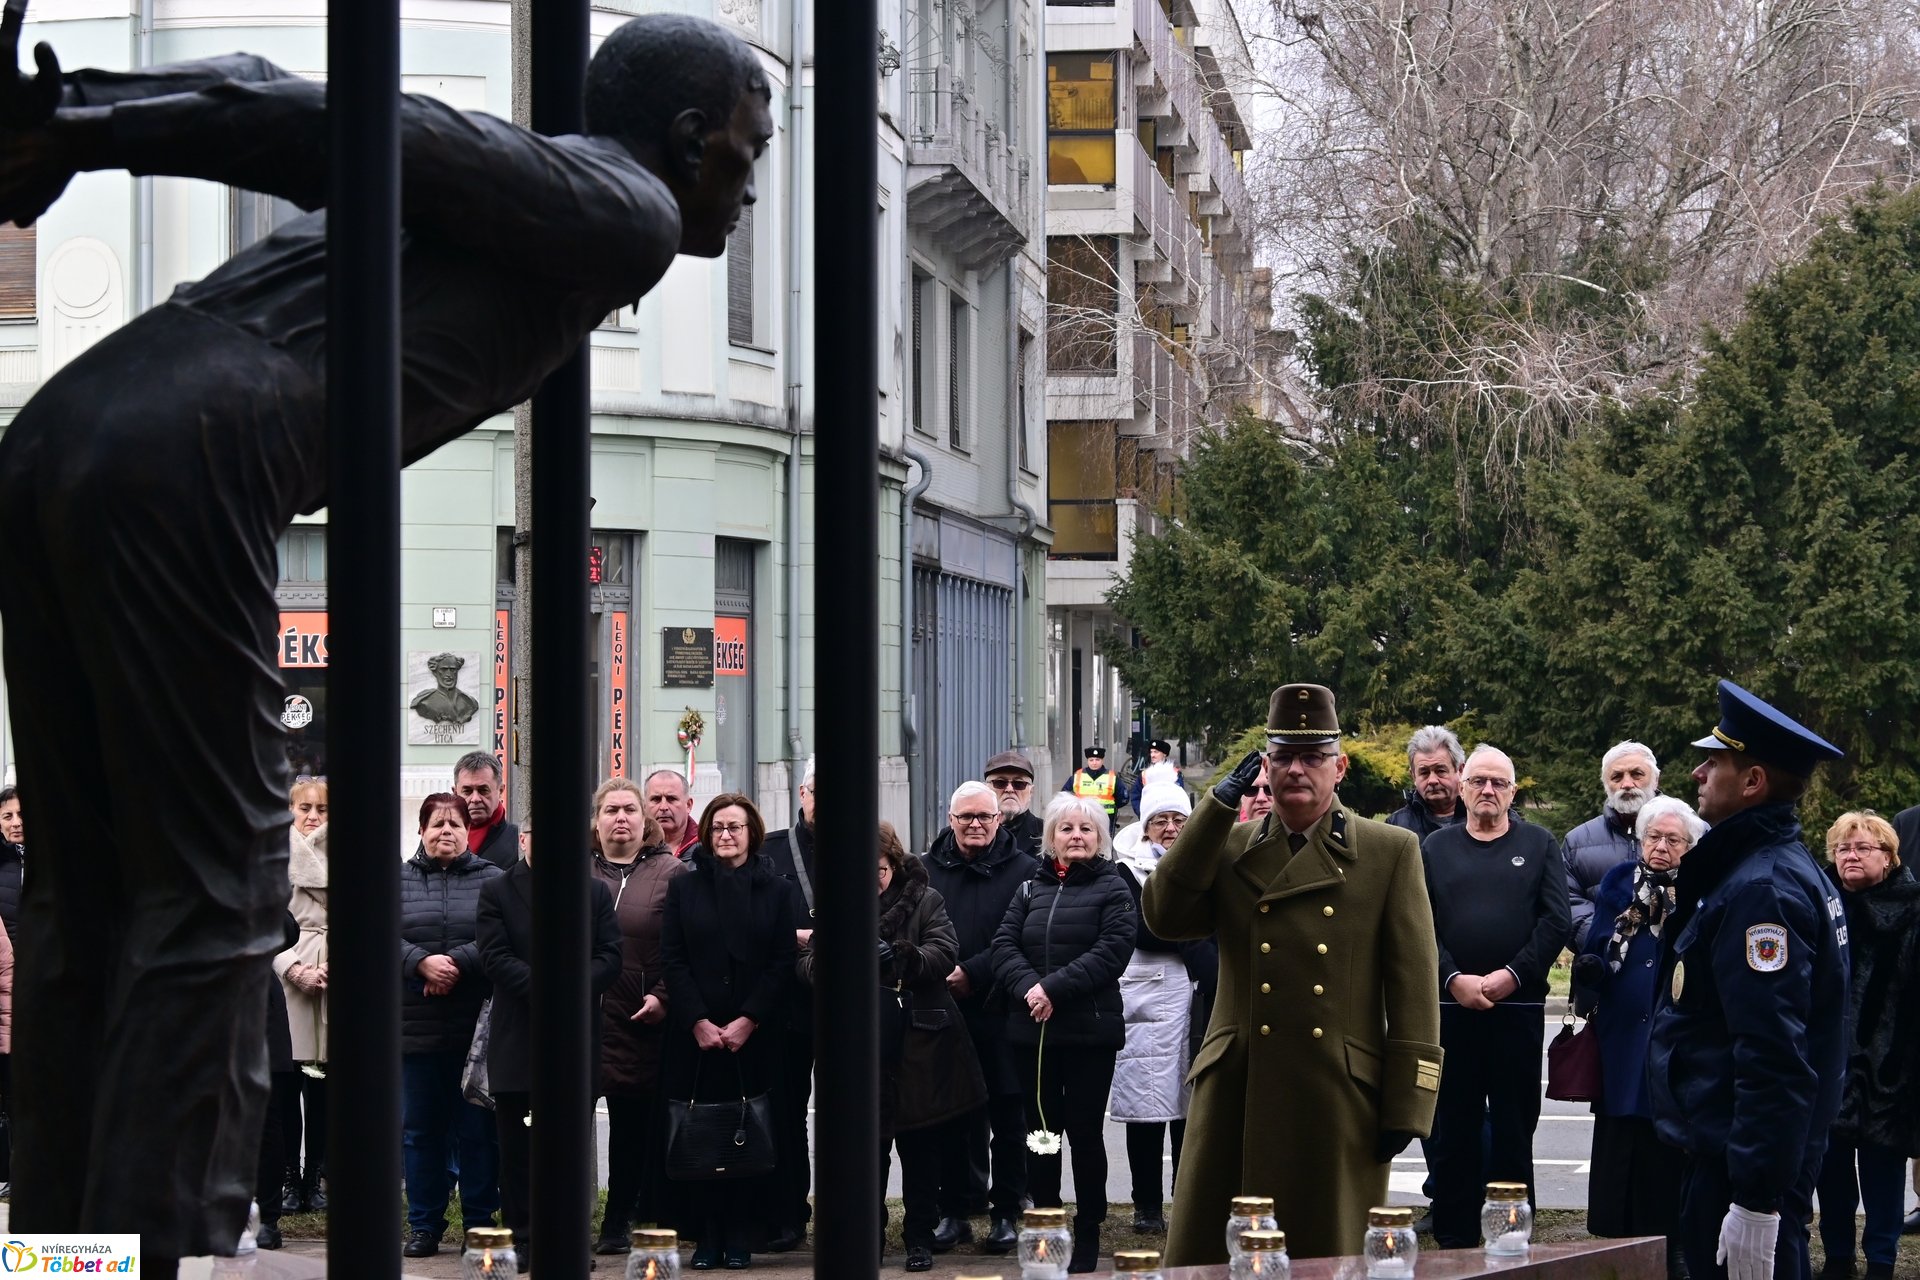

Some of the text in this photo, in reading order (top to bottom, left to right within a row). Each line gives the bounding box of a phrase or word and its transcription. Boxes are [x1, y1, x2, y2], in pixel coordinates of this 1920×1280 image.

[496, 619, 505, 675] LEONI
[716, 635, 744, 670] ÉKSÉG
[612, 620, 623, 778] LEONI PÉKS
[434, 733, 453, 744] UTCA
